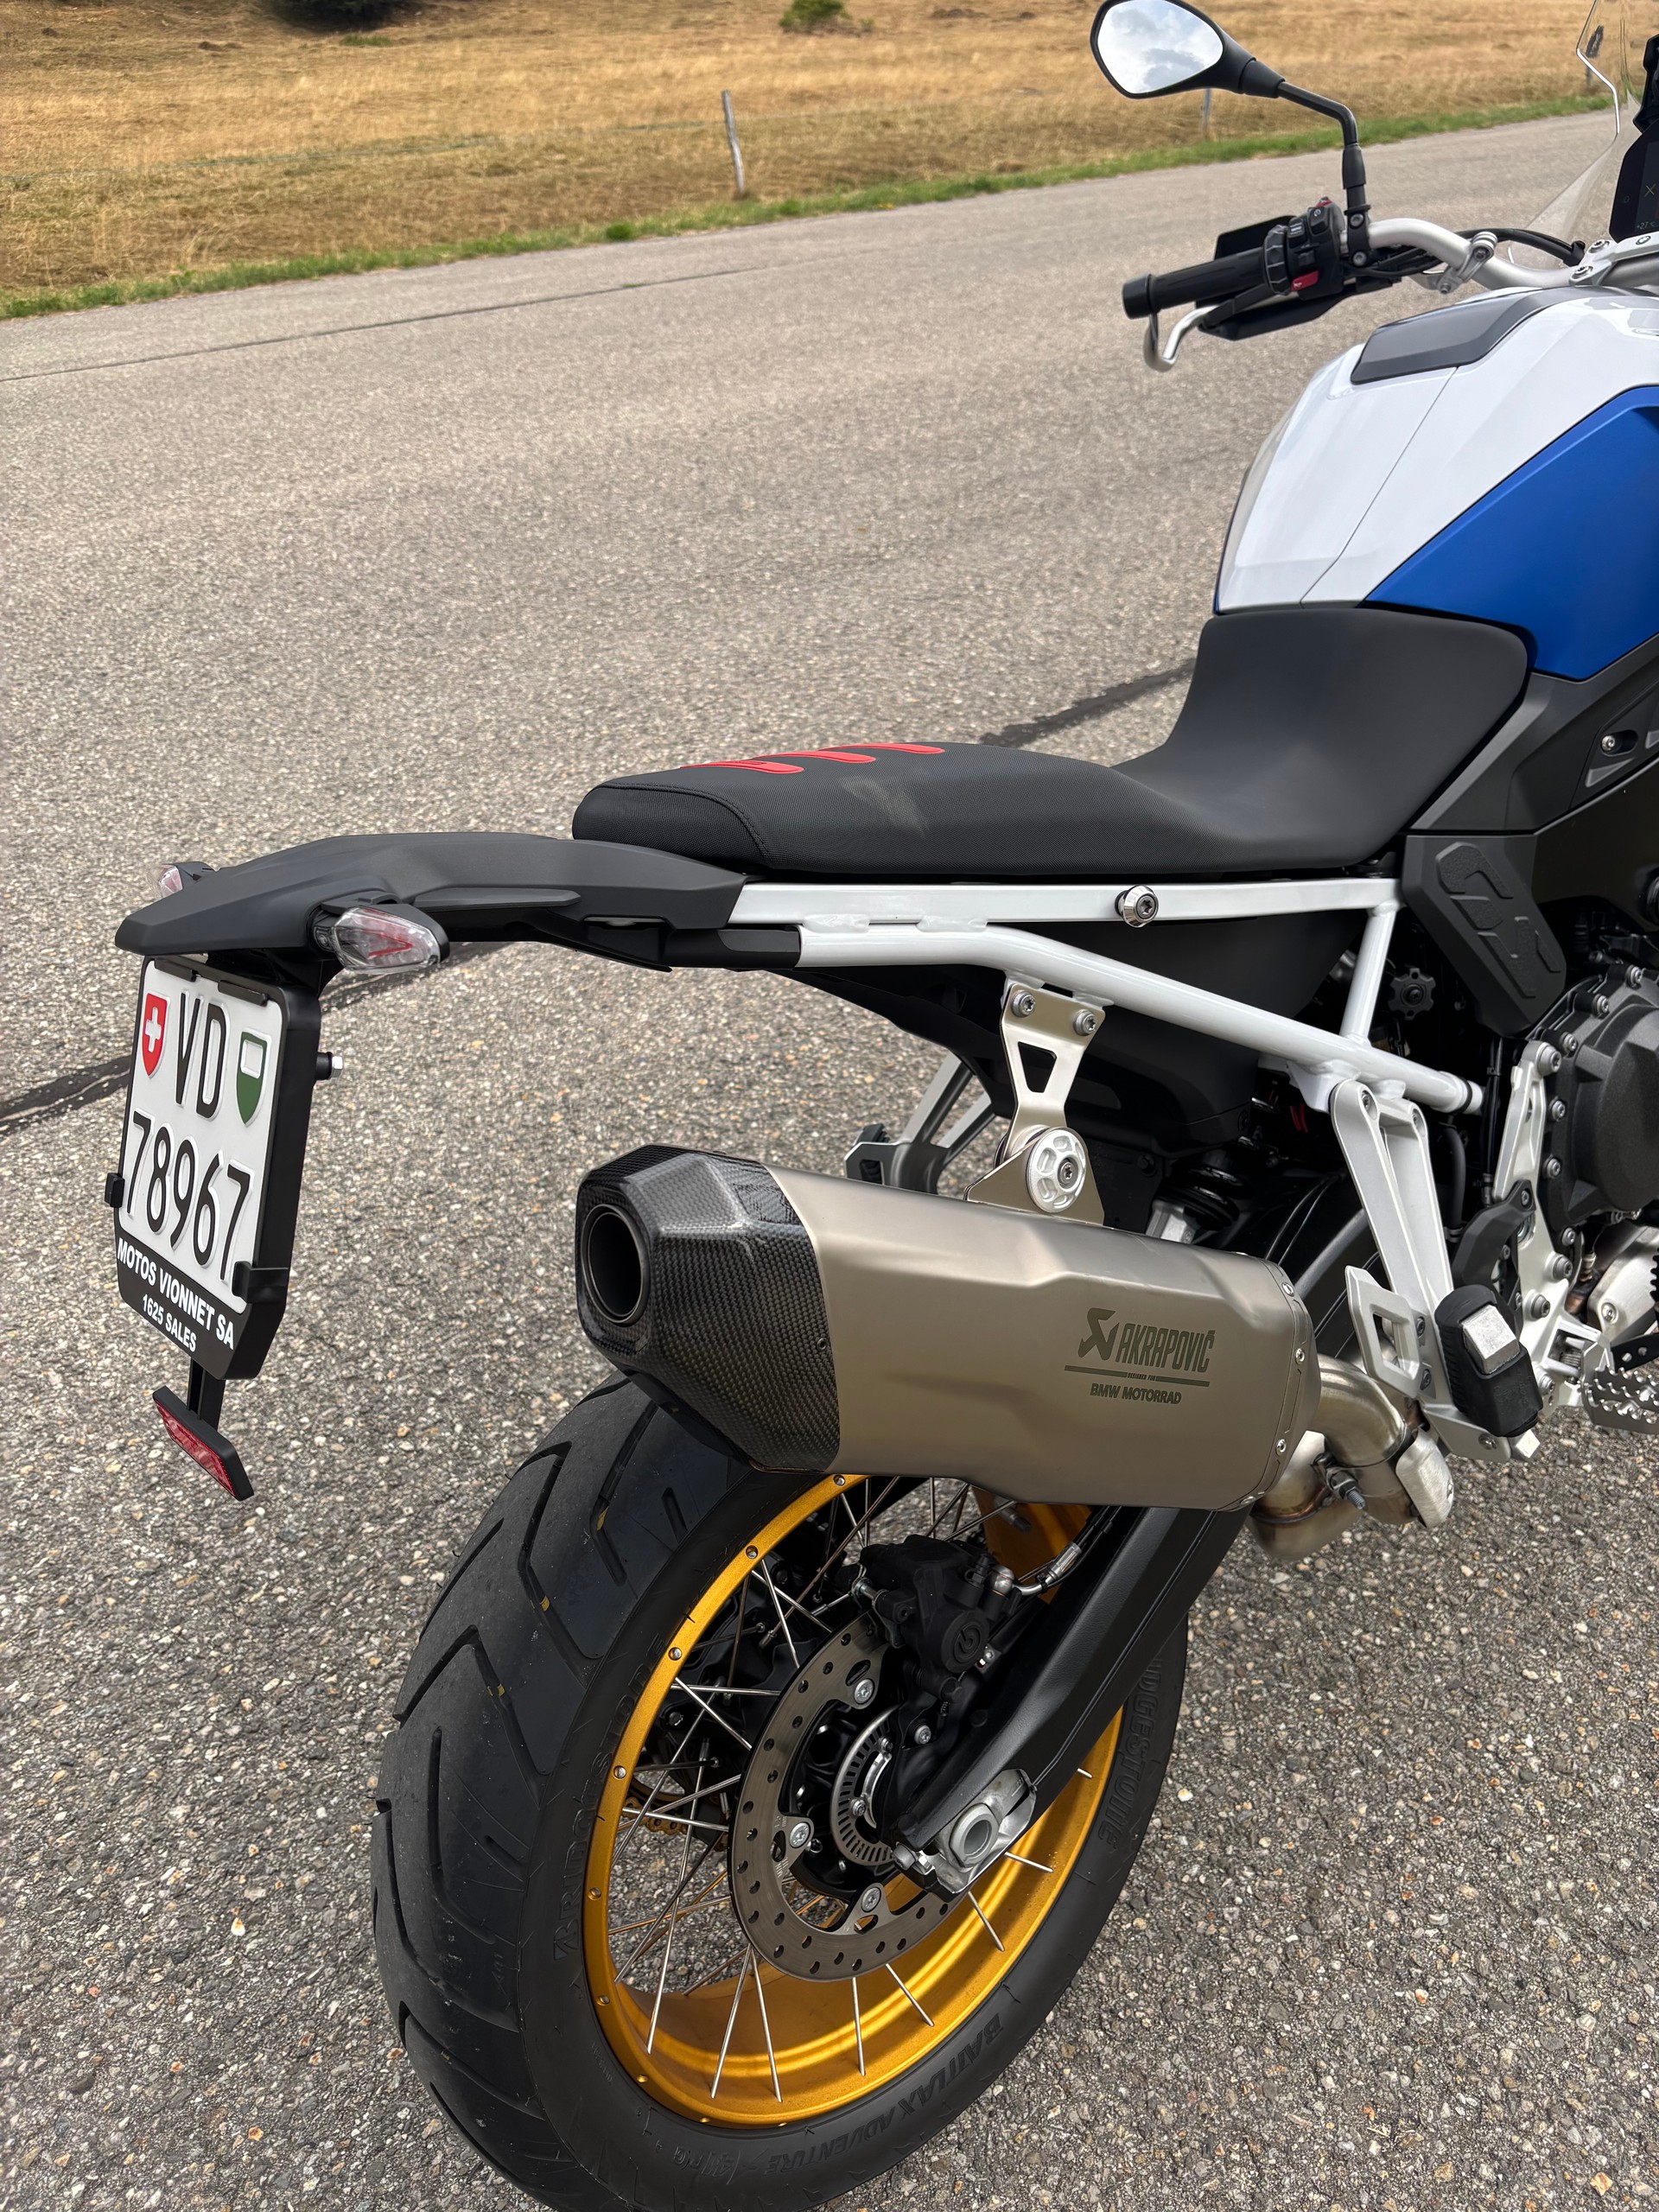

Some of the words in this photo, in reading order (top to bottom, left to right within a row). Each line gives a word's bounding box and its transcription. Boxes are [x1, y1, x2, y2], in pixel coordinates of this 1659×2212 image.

[176, 993, 226, 1119] VD
[126, 1111, 251, 1281] 78967
[117, 1237, 157, 1286] MOTOS
[159, 1268, 215, 1331] VIONNET
[216, 1314, 234, 1350] SA
[143, 1294, 164, 1325] 1625
[165, 1313, 197, 1352] SALES
[1090, 1382, 1121, 1398] BMW
[1122, 1386, 1182, 1404] MOTORRAD
[765, 2106, 896, 2176] ADVENTURE
